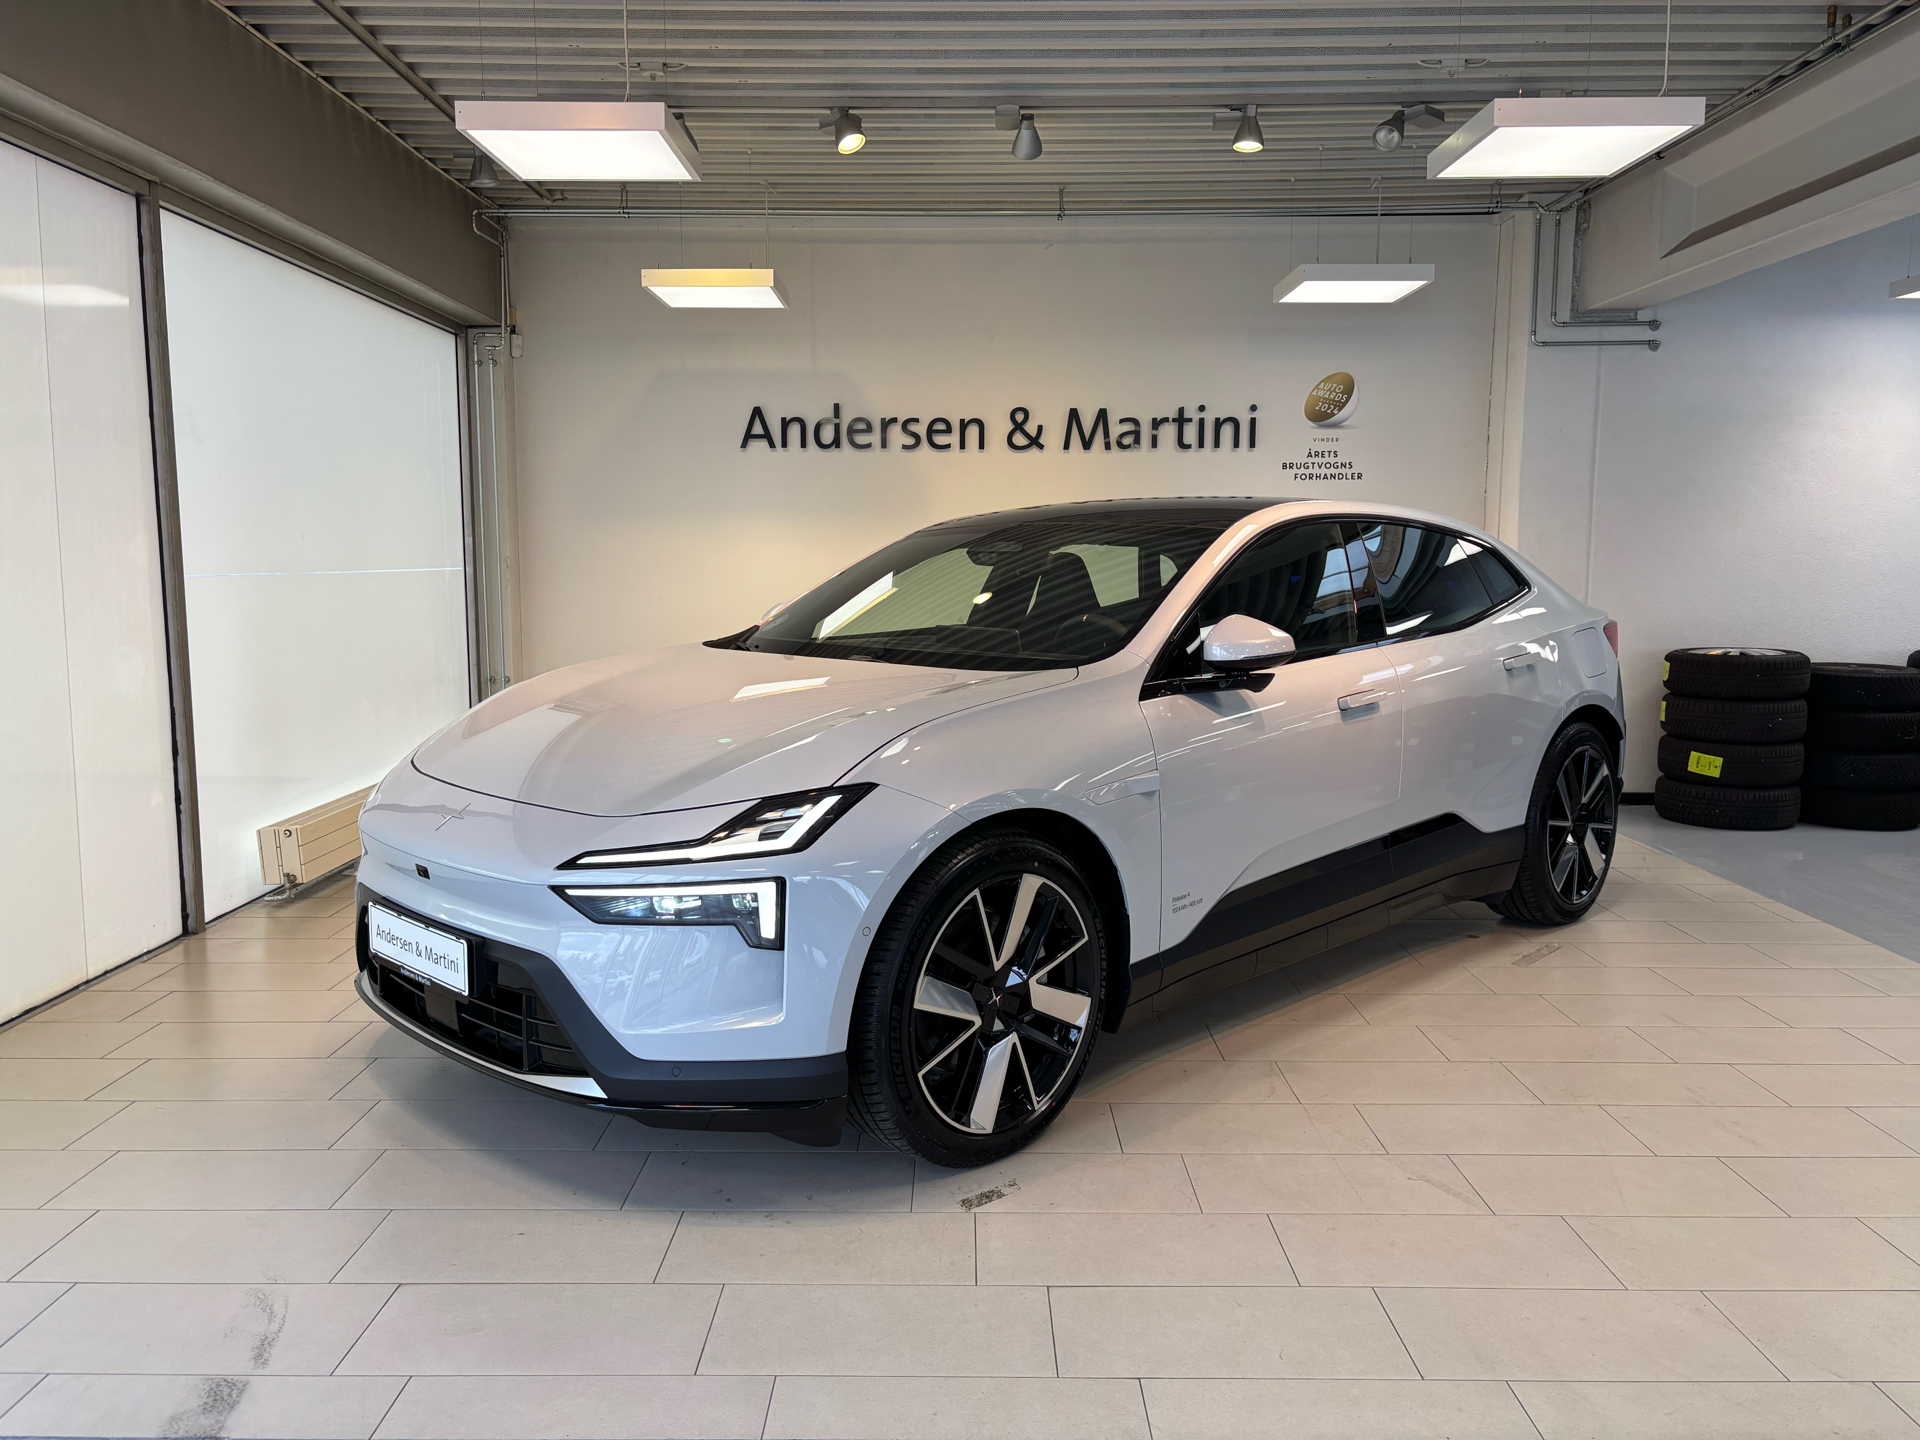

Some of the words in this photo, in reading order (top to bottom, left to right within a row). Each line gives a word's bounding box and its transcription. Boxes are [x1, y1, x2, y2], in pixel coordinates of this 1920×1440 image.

[1311, 388, 1348, 402] AWARDS
[1318, 382, 1344, 392] AUTO
[1315, 402, 1340, 415] 2024
[740, 403, 985, 450] Andersen
[1006, 406, 1045, 450] &
[1063, 404, 1257, 451] Martini
[1306, 448, 1339, 459] ÅRETS
[1282, 462, 1353, 470] BRUGTVOGNS
[1294, 472, 1363, 481] FORHANDLER
[910, 913, 932, 954] SPORT
[376, 924, 414, 954] Andersen
[415, 941, 423, 958] &
[424, 945, 459, 974] Martini
[1093, 917, 1106, 1000] MICHELIN
[897, 956, 912, 991] PILOT
[888, 1005, 911, 1099] MICHELIN
